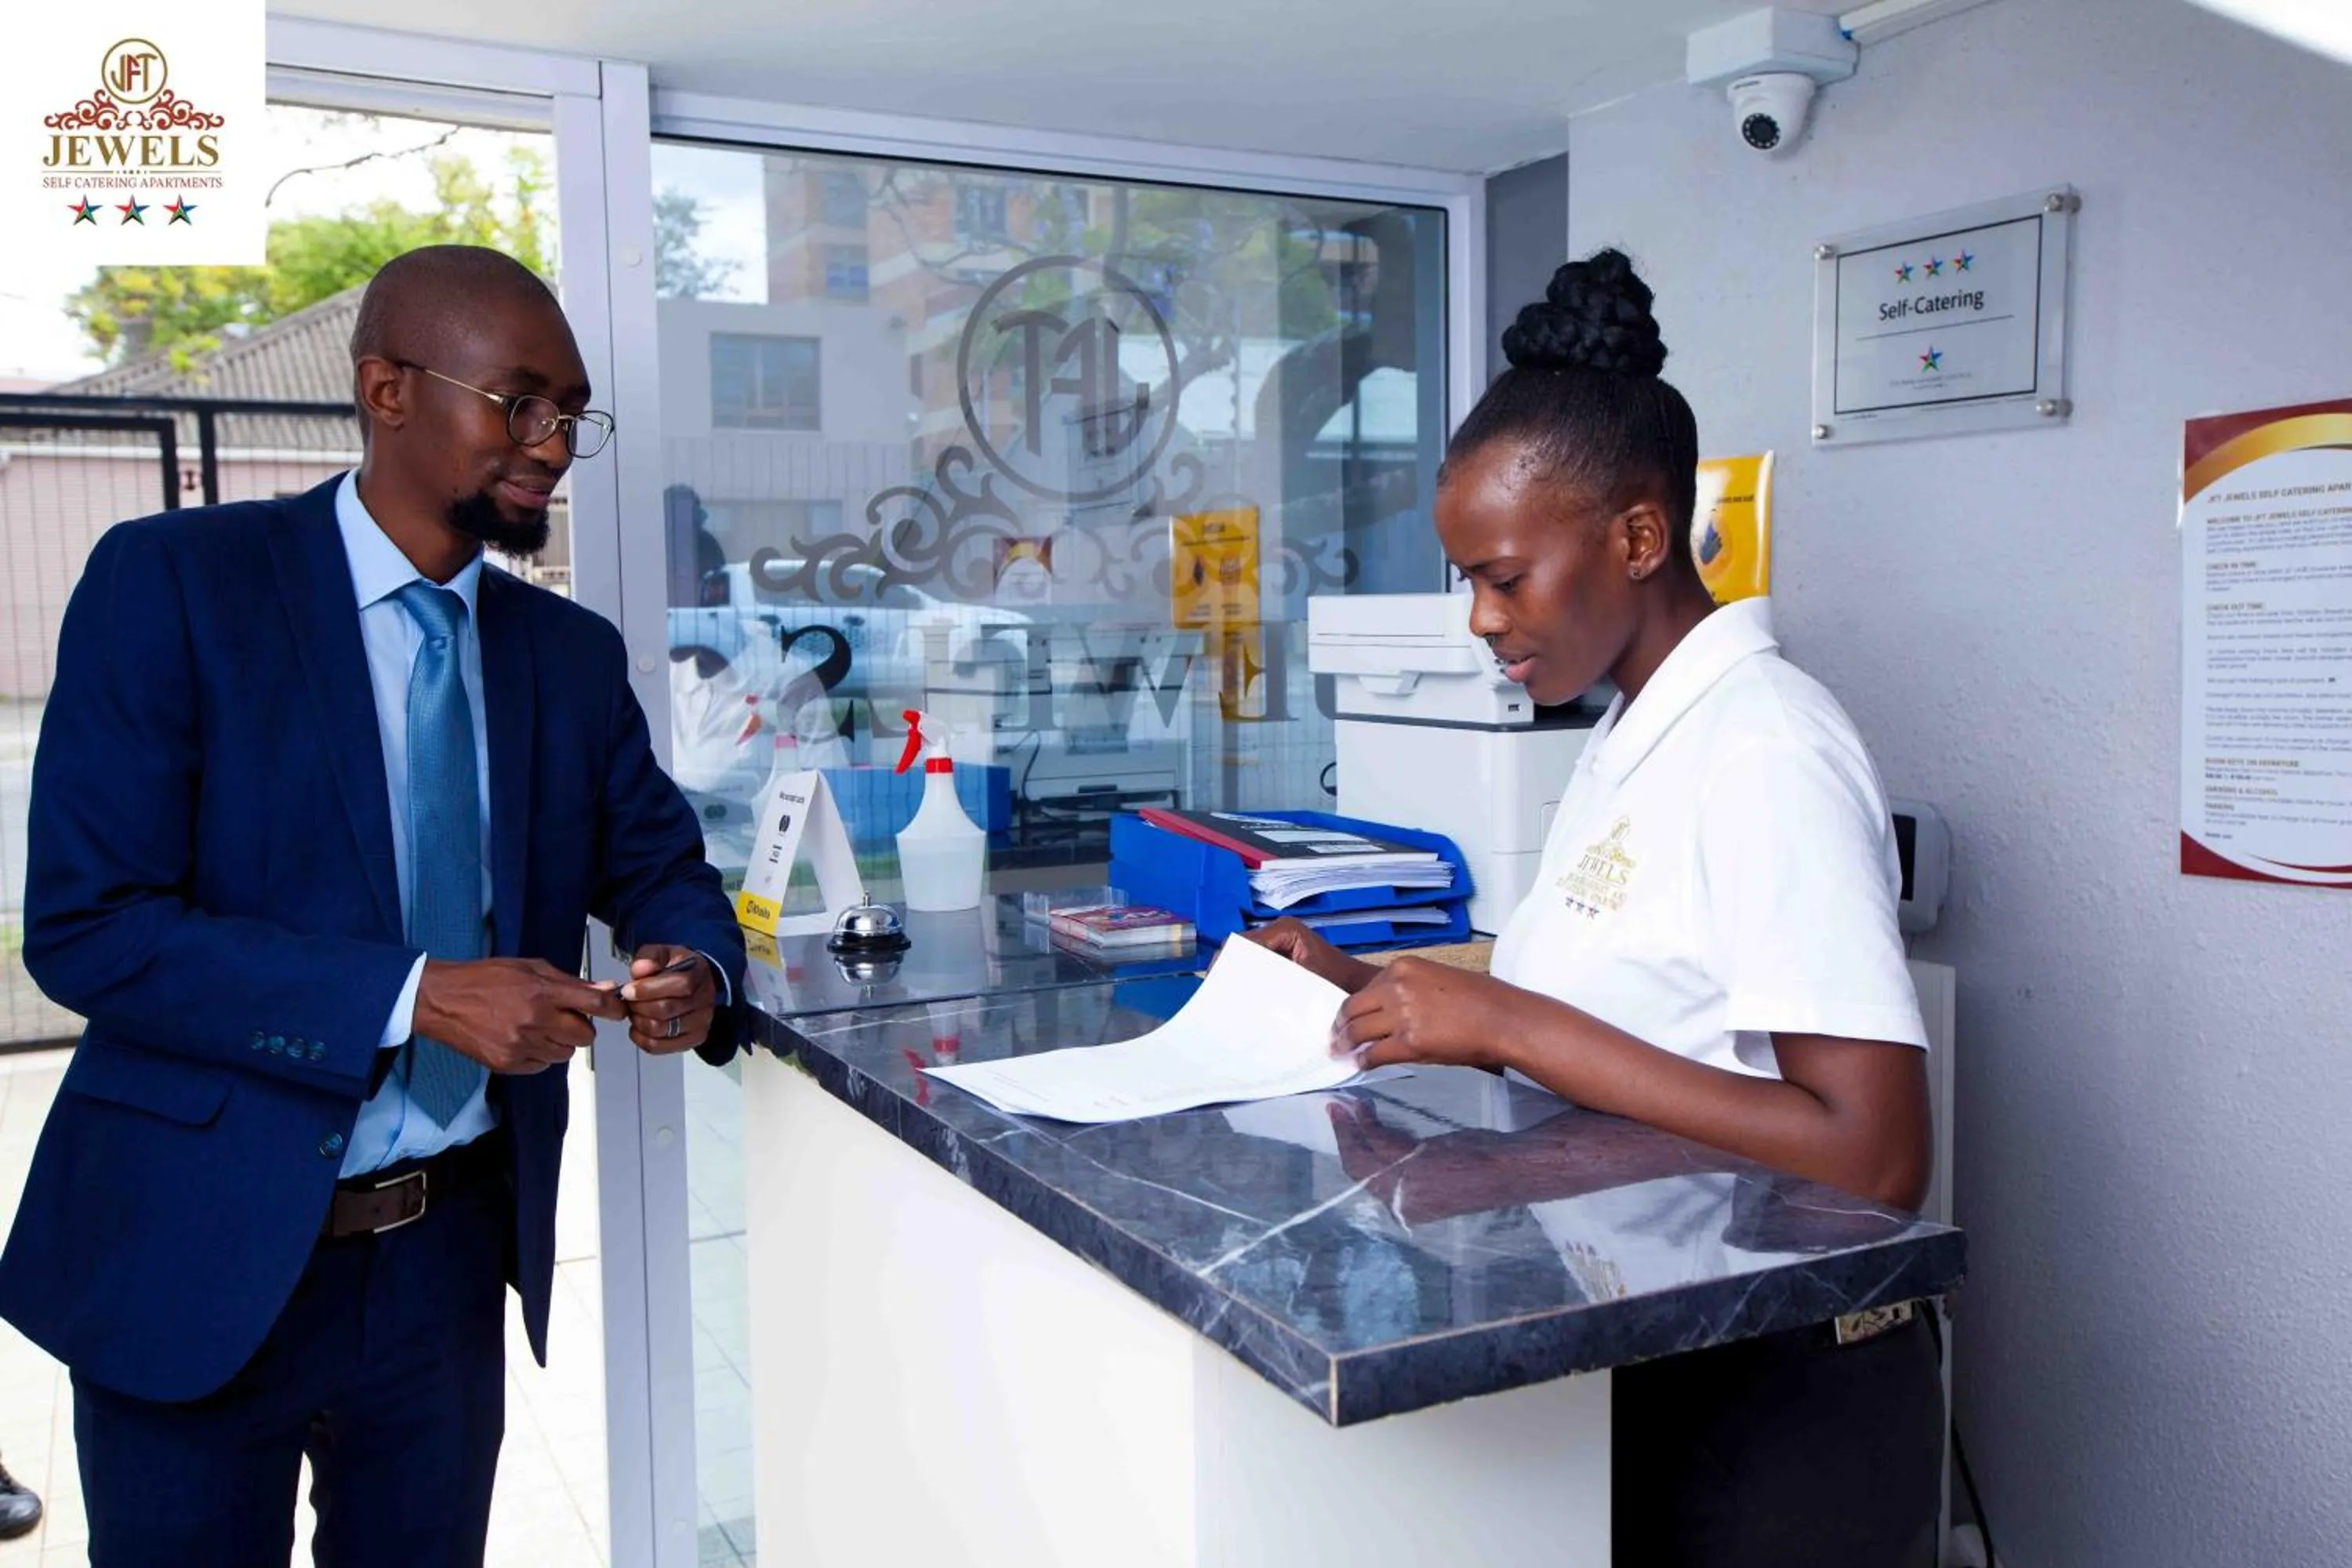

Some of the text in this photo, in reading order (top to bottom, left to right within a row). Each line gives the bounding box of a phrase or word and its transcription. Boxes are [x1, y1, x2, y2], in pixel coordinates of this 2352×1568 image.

[1878, 289, 1984, 321] Self-Catering
[2223, 491, 2256, 501] JEWELS
[2259, 489, 2279, 499] SELF
[2281, 485, 2325, 497] CATERING
